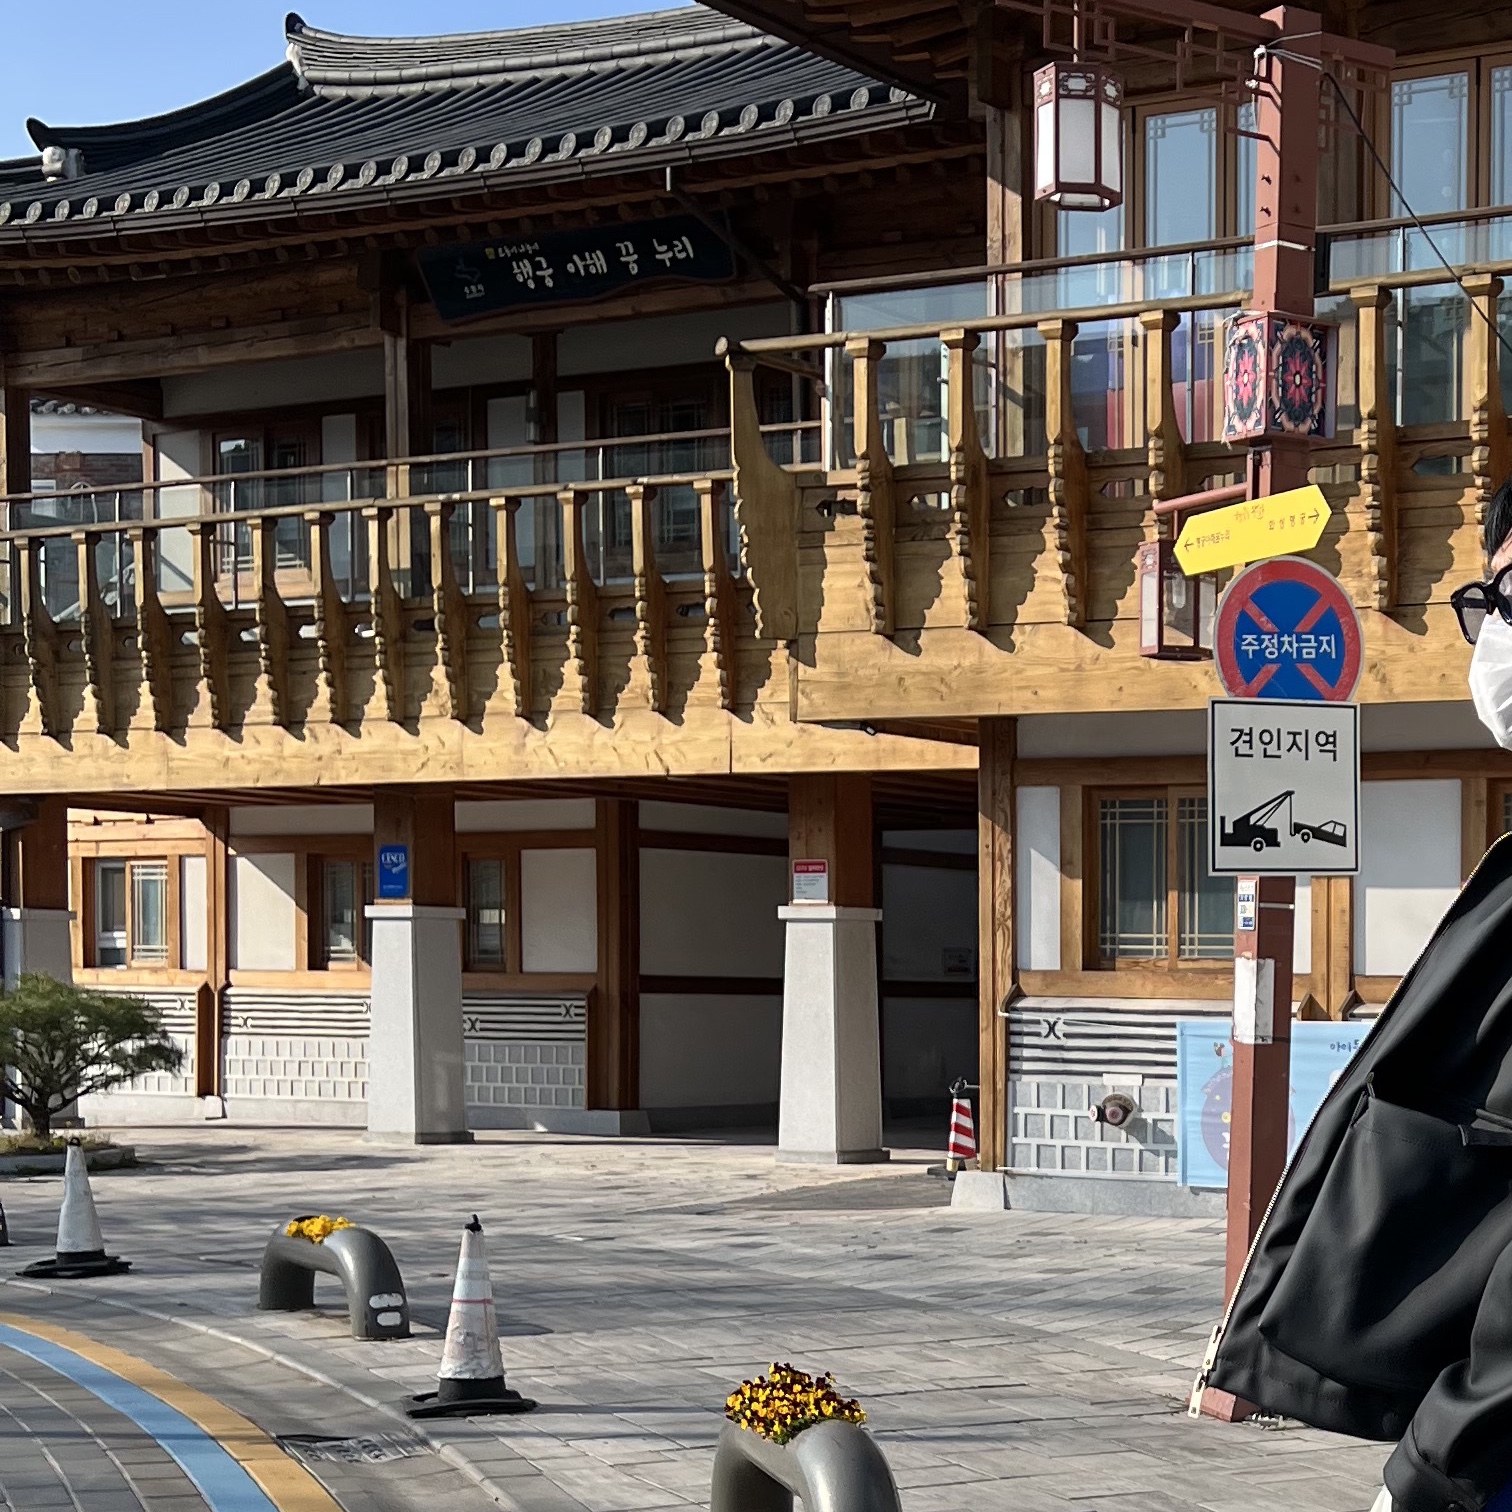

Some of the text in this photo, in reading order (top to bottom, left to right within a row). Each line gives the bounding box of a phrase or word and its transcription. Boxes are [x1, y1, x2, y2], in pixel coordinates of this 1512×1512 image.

[511, 256, 555, 290] 행궁
[566, 249, 608, 276] 아해
[652, 235, 695, 268] 누리
[1240, 633, 1337, 660] 주정차금지
[1229, 726, 1338, 763] 견인지역
